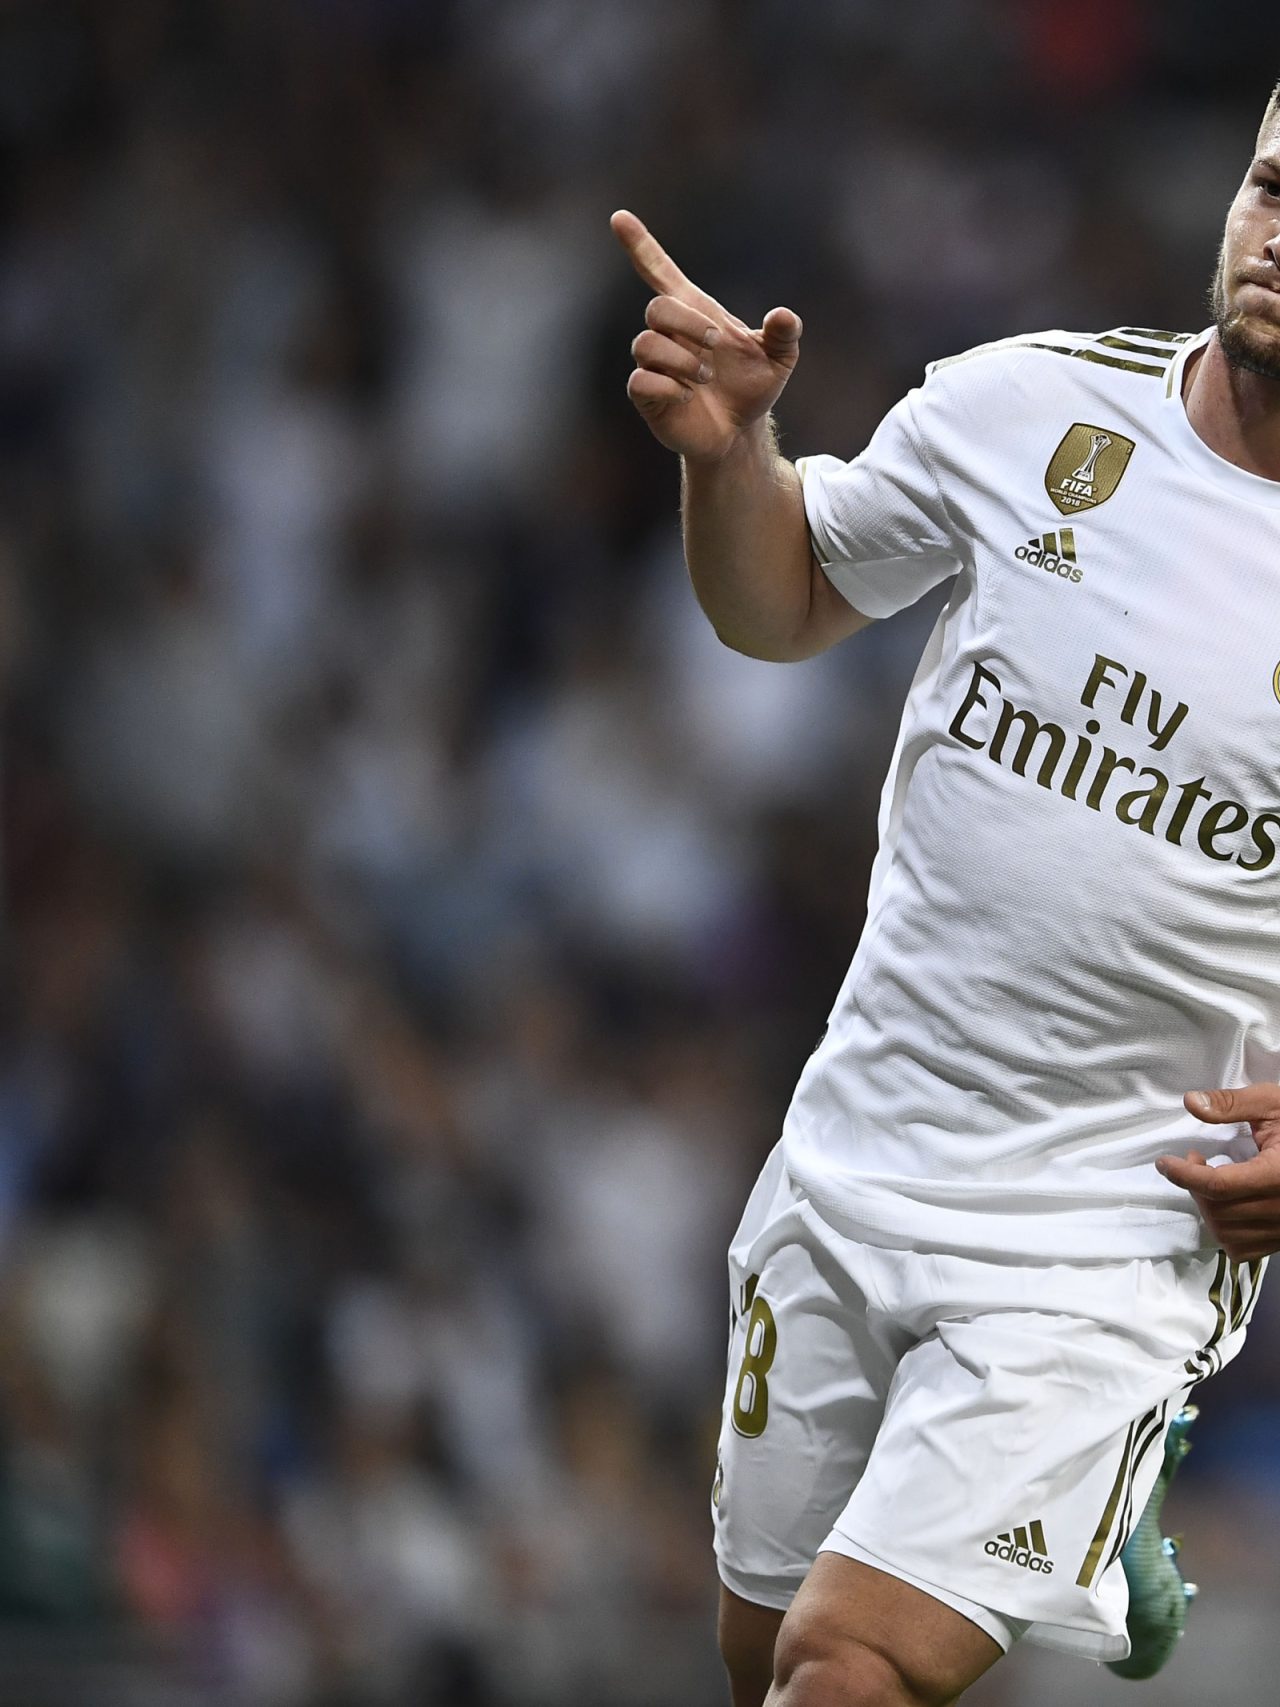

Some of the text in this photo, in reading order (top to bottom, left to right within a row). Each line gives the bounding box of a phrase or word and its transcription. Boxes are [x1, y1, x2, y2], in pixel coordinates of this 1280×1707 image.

[1060, 478, 1093, 497] FIFA
[1060, 496, 1081, 507] 2018
[1014, 545, 1084, 583] adidas
[1080, 653, 1189, 751] Fly
[984, 1541, 1054, 1574] adidas
